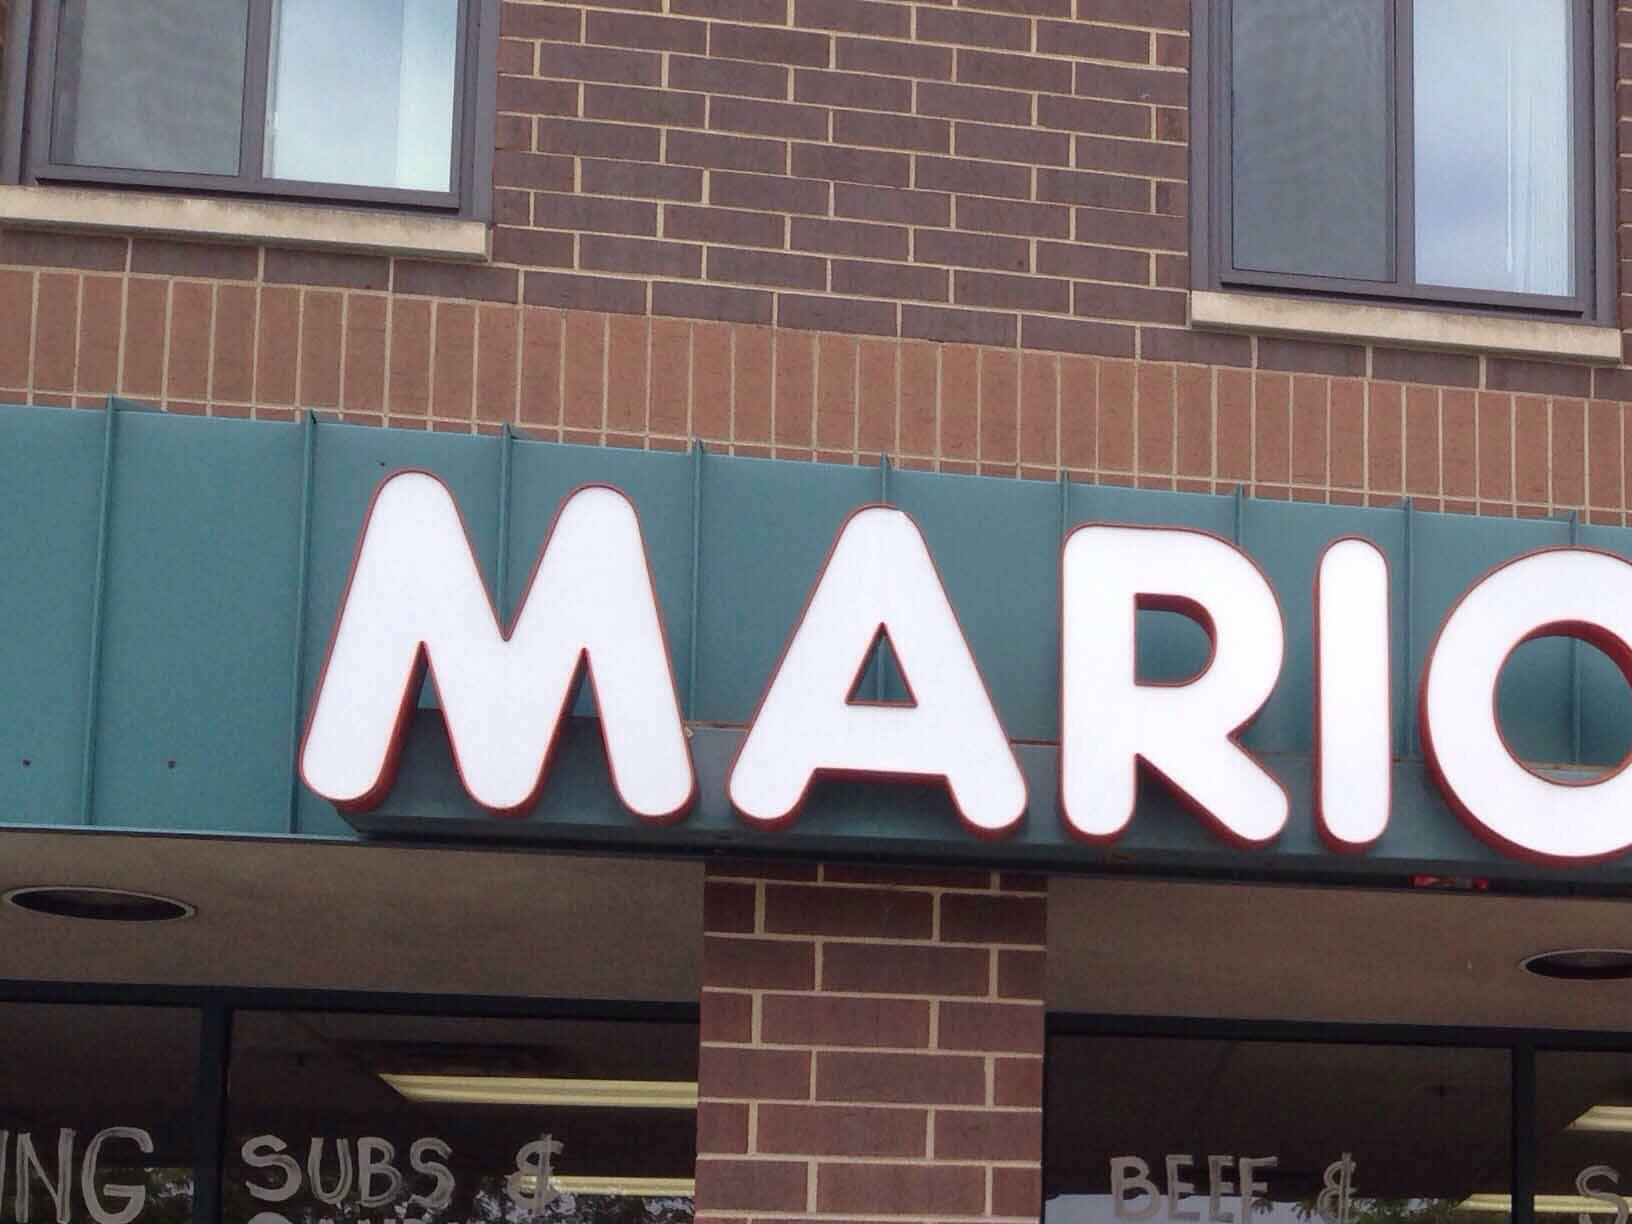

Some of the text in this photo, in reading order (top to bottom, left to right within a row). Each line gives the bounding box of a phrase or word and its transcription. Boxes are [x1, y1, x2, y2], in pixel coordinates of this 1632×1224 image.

[240, 1132, 564, 1216] SUBS &
[1110, 1154, 1278, 1224] BEEF
